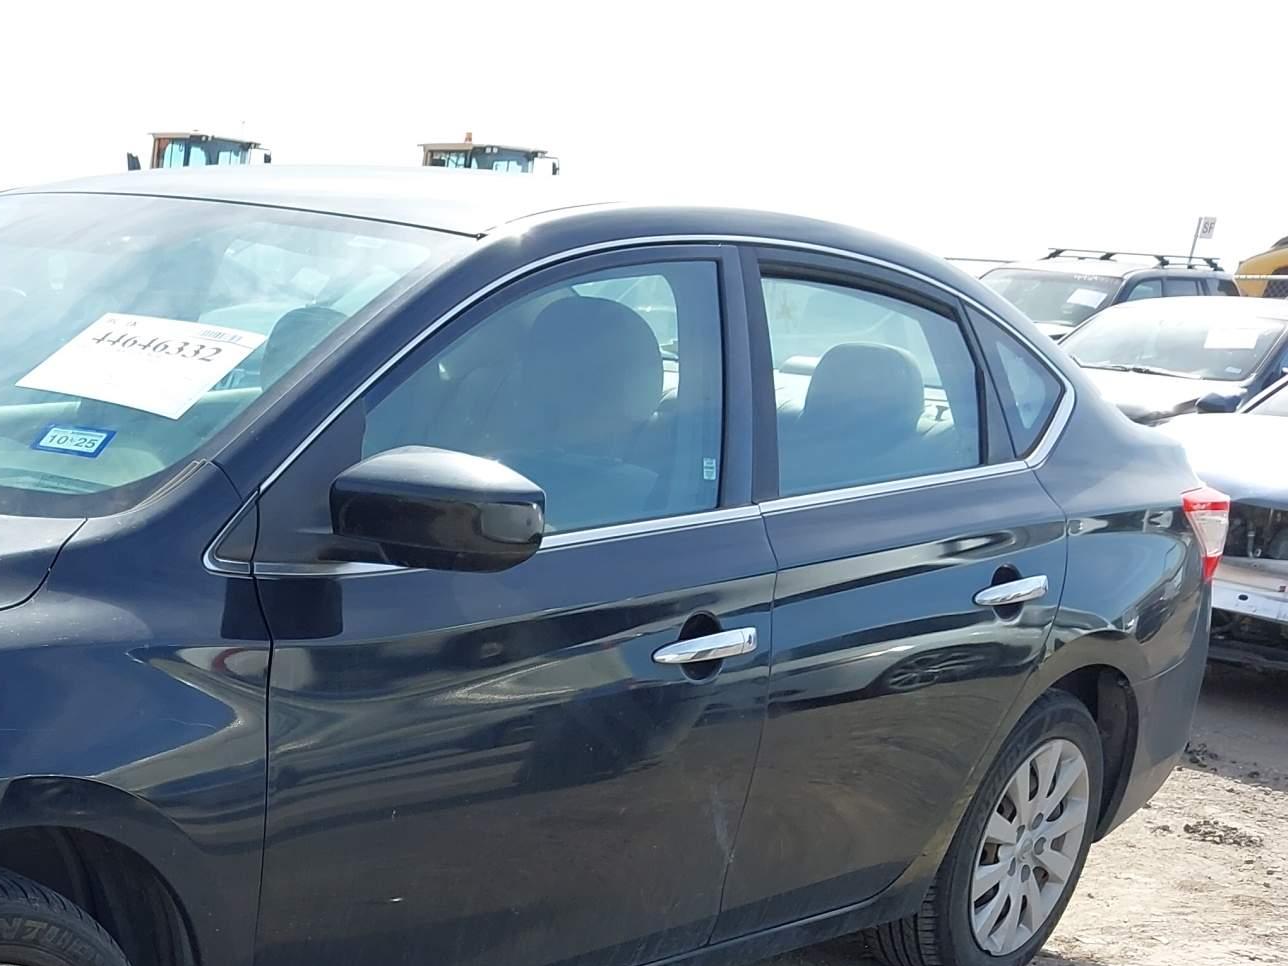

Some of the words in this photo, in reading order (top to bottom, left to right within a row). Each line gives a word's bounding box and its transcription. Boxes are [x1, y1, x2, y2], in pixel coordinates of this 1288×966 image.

[92, 331, 223, 362] 44646332
[48, 434, 69, 445] 10
[74, 437, 98, 449] 25
